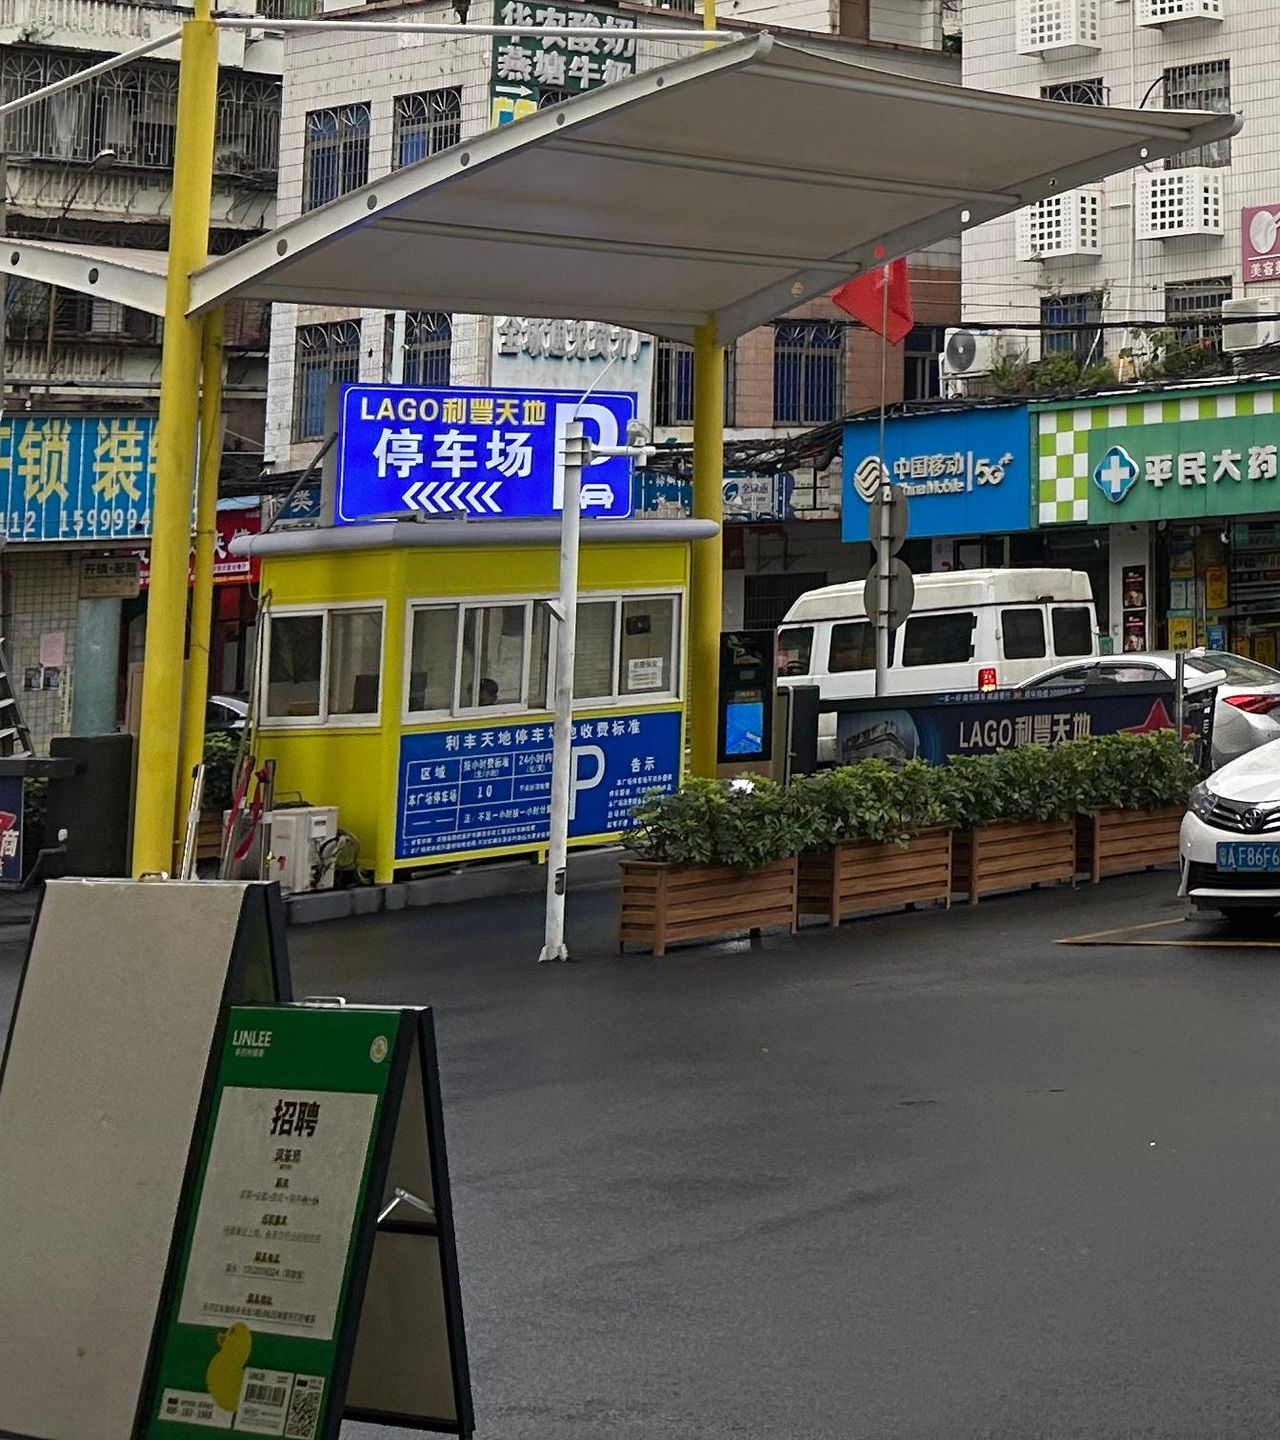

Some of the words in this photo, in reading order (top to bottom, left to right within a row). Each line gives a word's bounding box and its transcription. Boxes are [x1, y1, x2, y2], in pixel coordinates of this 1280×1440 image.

[500, 0, 636, 58] 华农酸奶
[0, 419, 71, 504] 锁
[92, 419, 160, 502] 装
[373, 429, 533, 478] 停车场
[553, 403, 619, 510] P
[893, 451, 965, 480] 中国移动
[928, 480, 964, 496] Mobile
[445, 719, 641, 751] 利丰天地停车收费标准
[233, 1029, 272, 1048] LINLEE
[270, 1099, 320, 1137] 招聘
